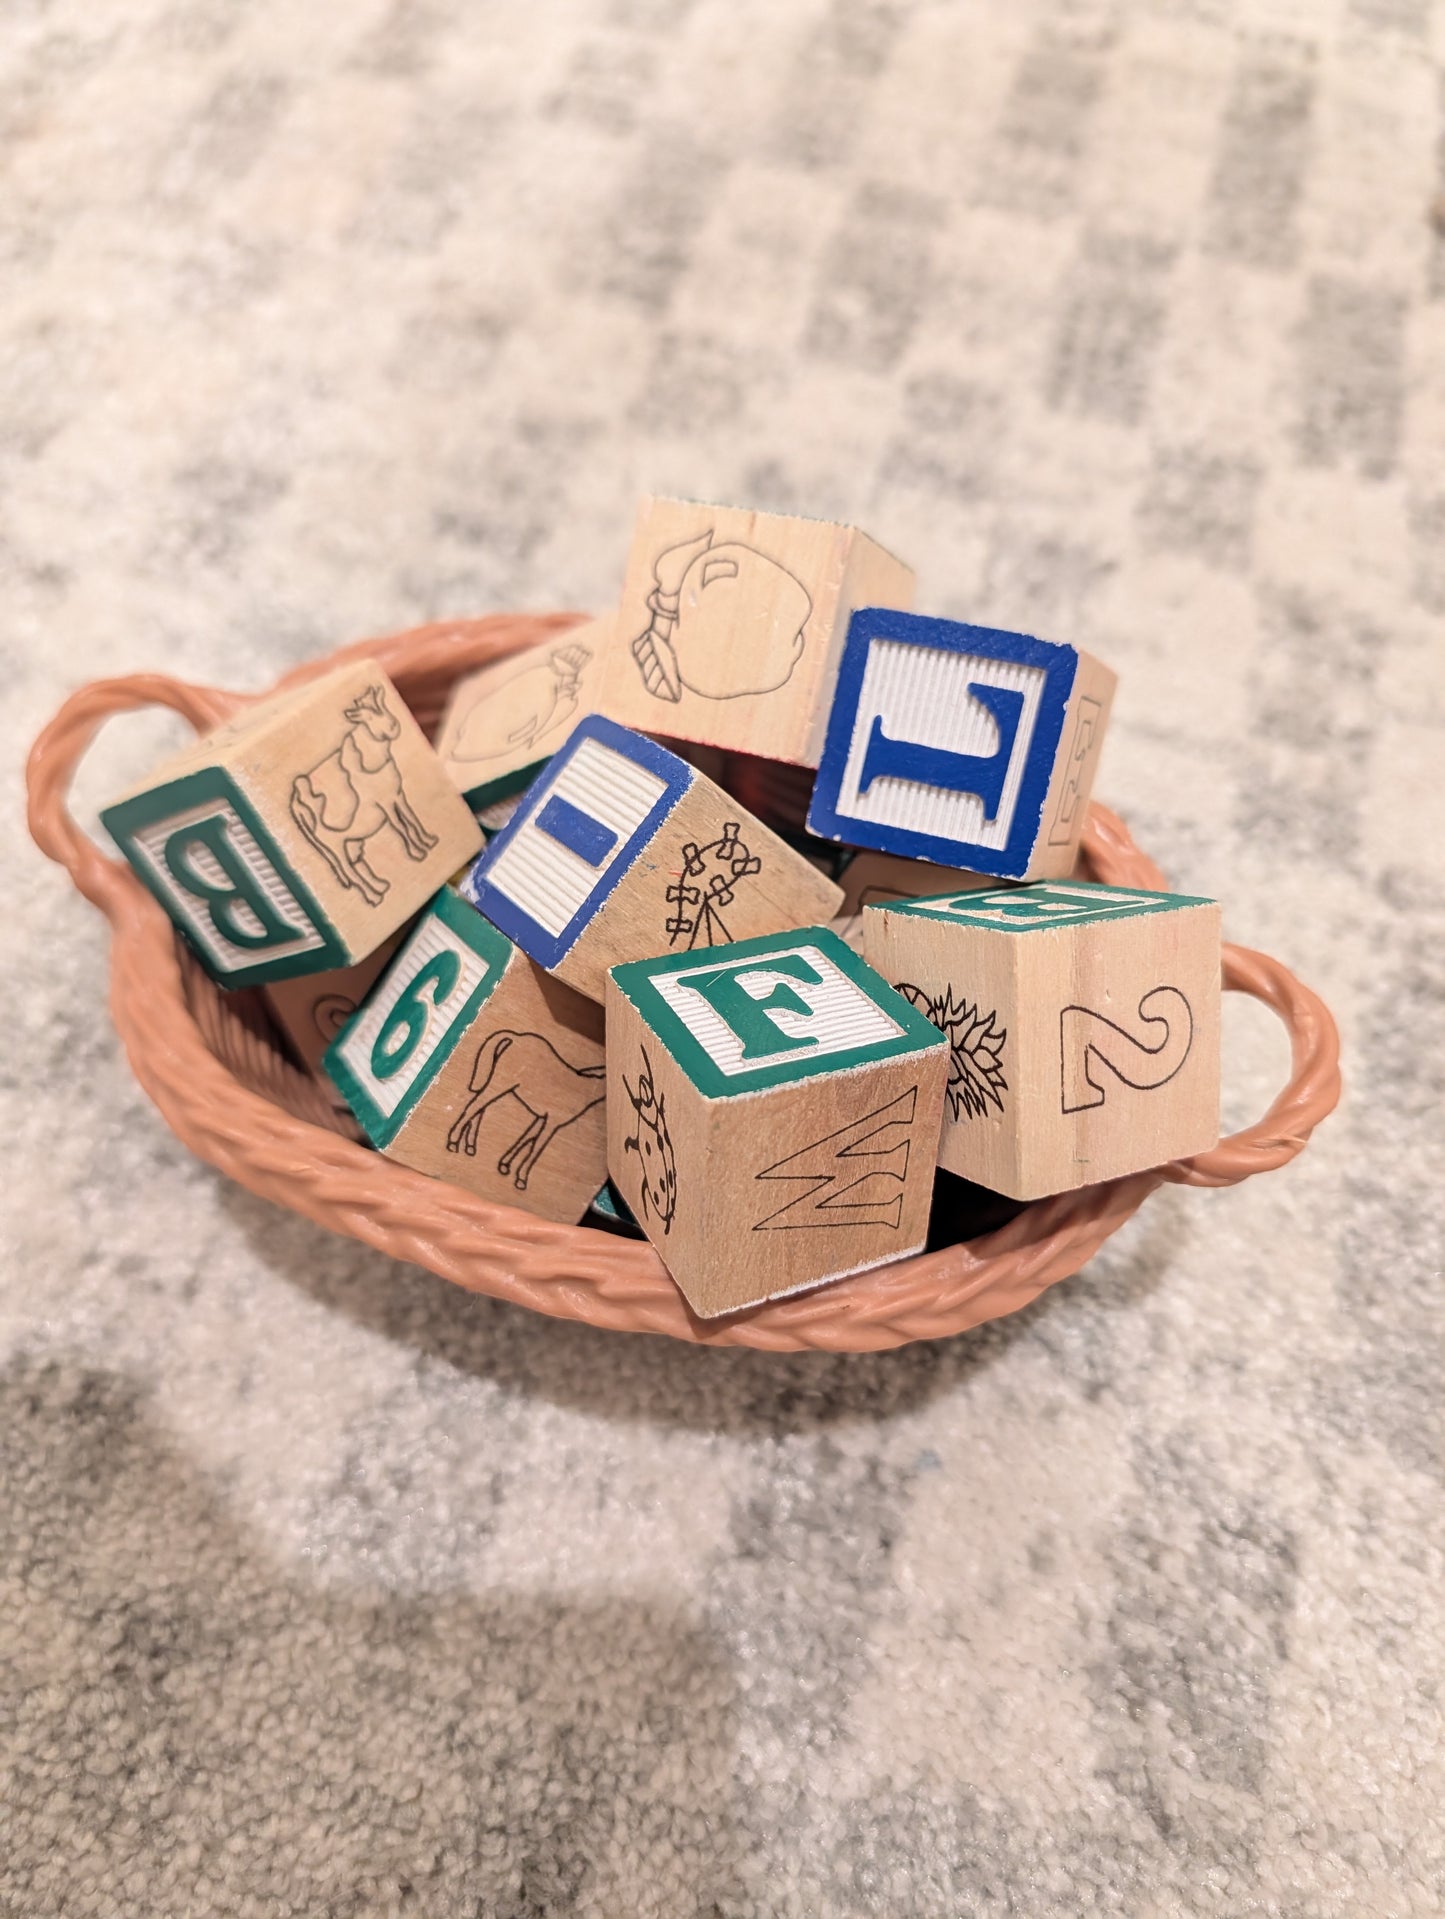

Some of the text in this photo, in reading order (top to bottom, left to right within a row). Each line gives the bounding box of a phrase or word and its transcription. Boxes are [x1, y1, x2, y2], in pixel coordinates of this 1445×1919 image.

[856, 682, 1023, 820] L
[164, 815, 304, 950] B
[370, 950, 461, 1078] 6
[677, 954, 823, 1059] F
[1061, 986, 1192, 1113] 2
[753, 1086, 917, 1230] W
